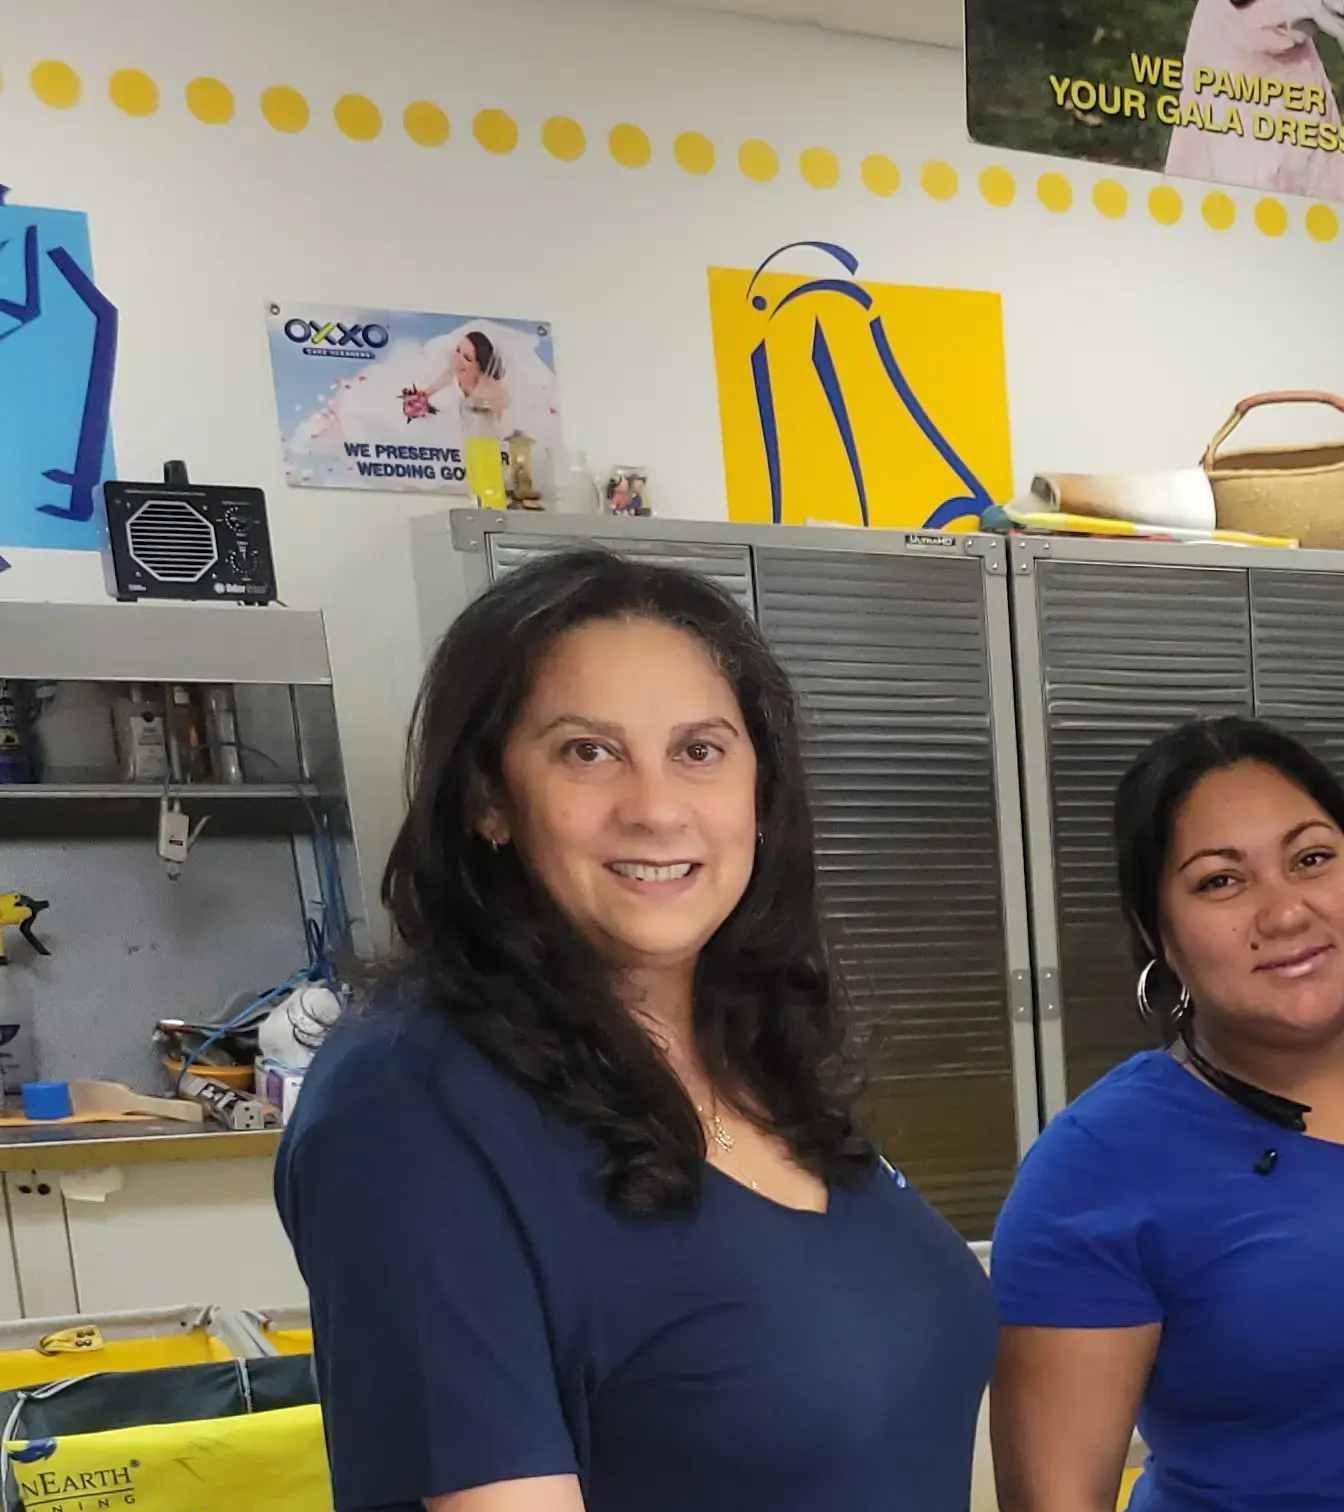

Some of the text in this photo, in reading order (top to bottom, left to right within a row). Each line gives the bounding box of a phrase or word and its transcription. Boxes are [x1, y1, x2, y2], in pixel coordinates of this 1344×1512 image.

[1131, 52, 1326, 115] WE PAMPER
[1049, 74, 1147, 119] YOUR
[1156, 97, 1244, 136] GALA
[284, 318, 389, 349] OXXO
[344, 442, 462, 463] WE PRESERVE
[356, 461, 466, 482] WEDDING GO
